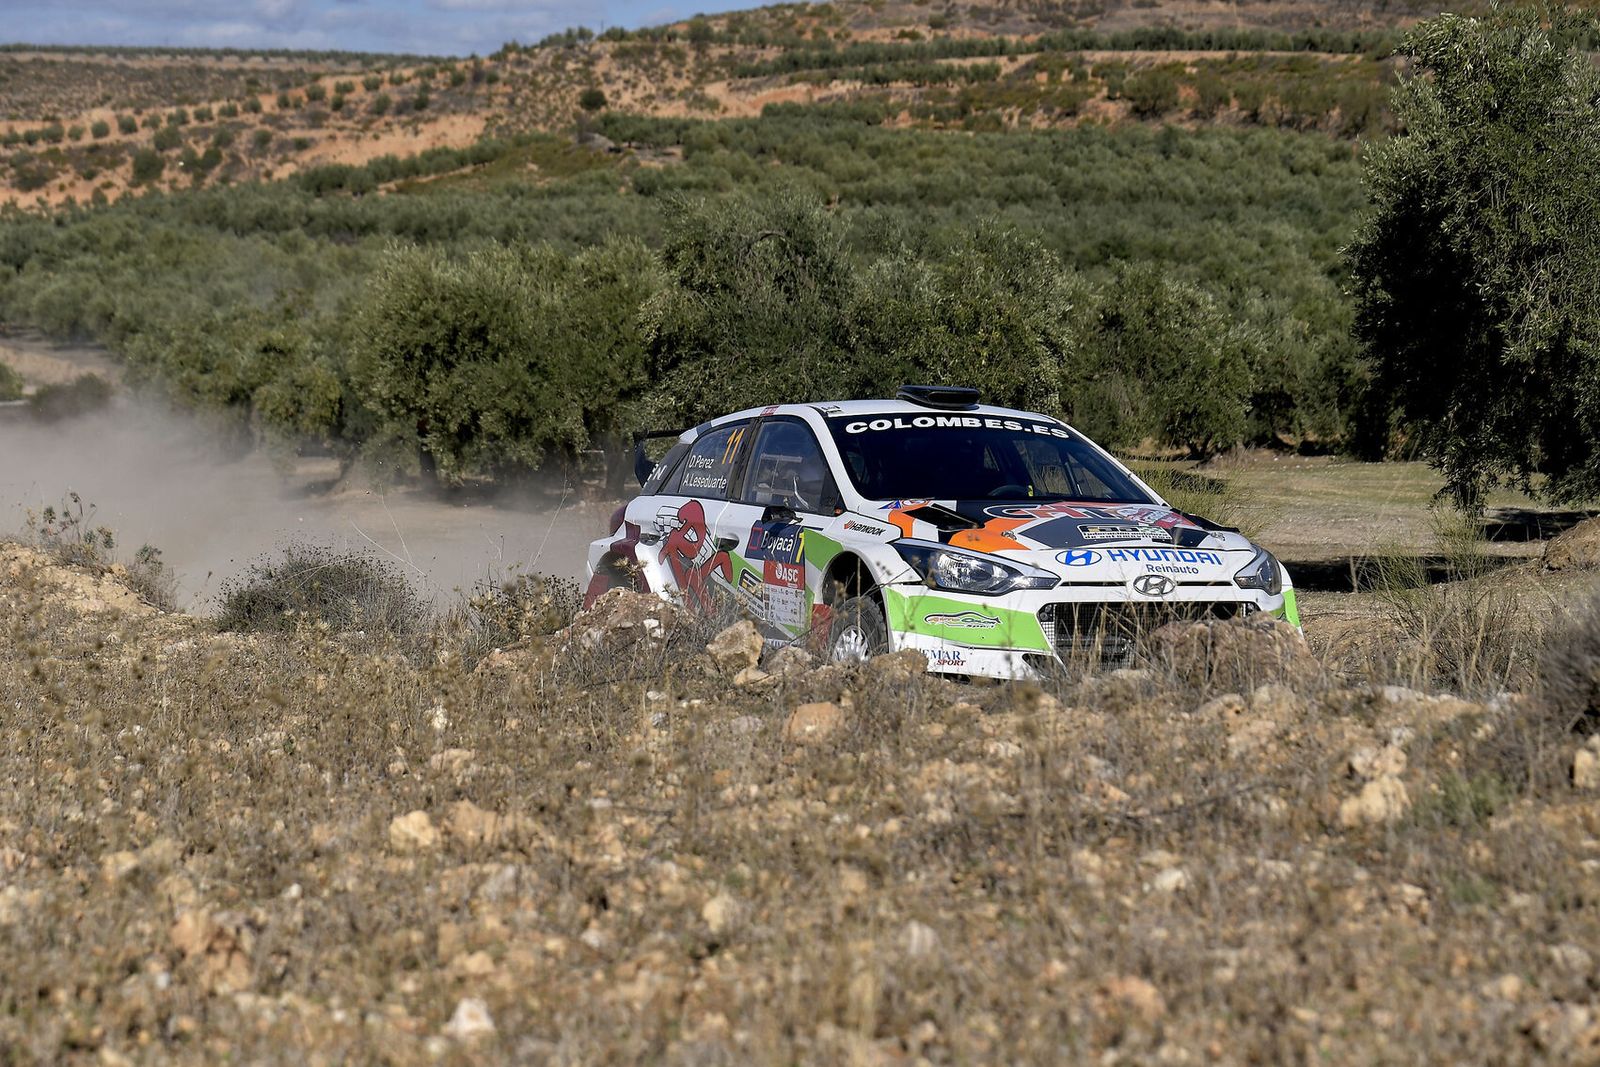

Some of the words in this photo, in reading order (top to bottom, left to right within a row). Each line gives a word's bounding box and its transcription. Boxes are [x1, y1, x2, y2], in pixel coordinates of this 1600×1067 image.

[845, 416, 1069, 439] COLOMBES.ES
[722, 428, 746, 465] 11
[761, 531, 793, 555] Boyacá
[1107, 549, 1222, 566] HYUNDAI
[1146, 564, 1199, 574] Reinauto
